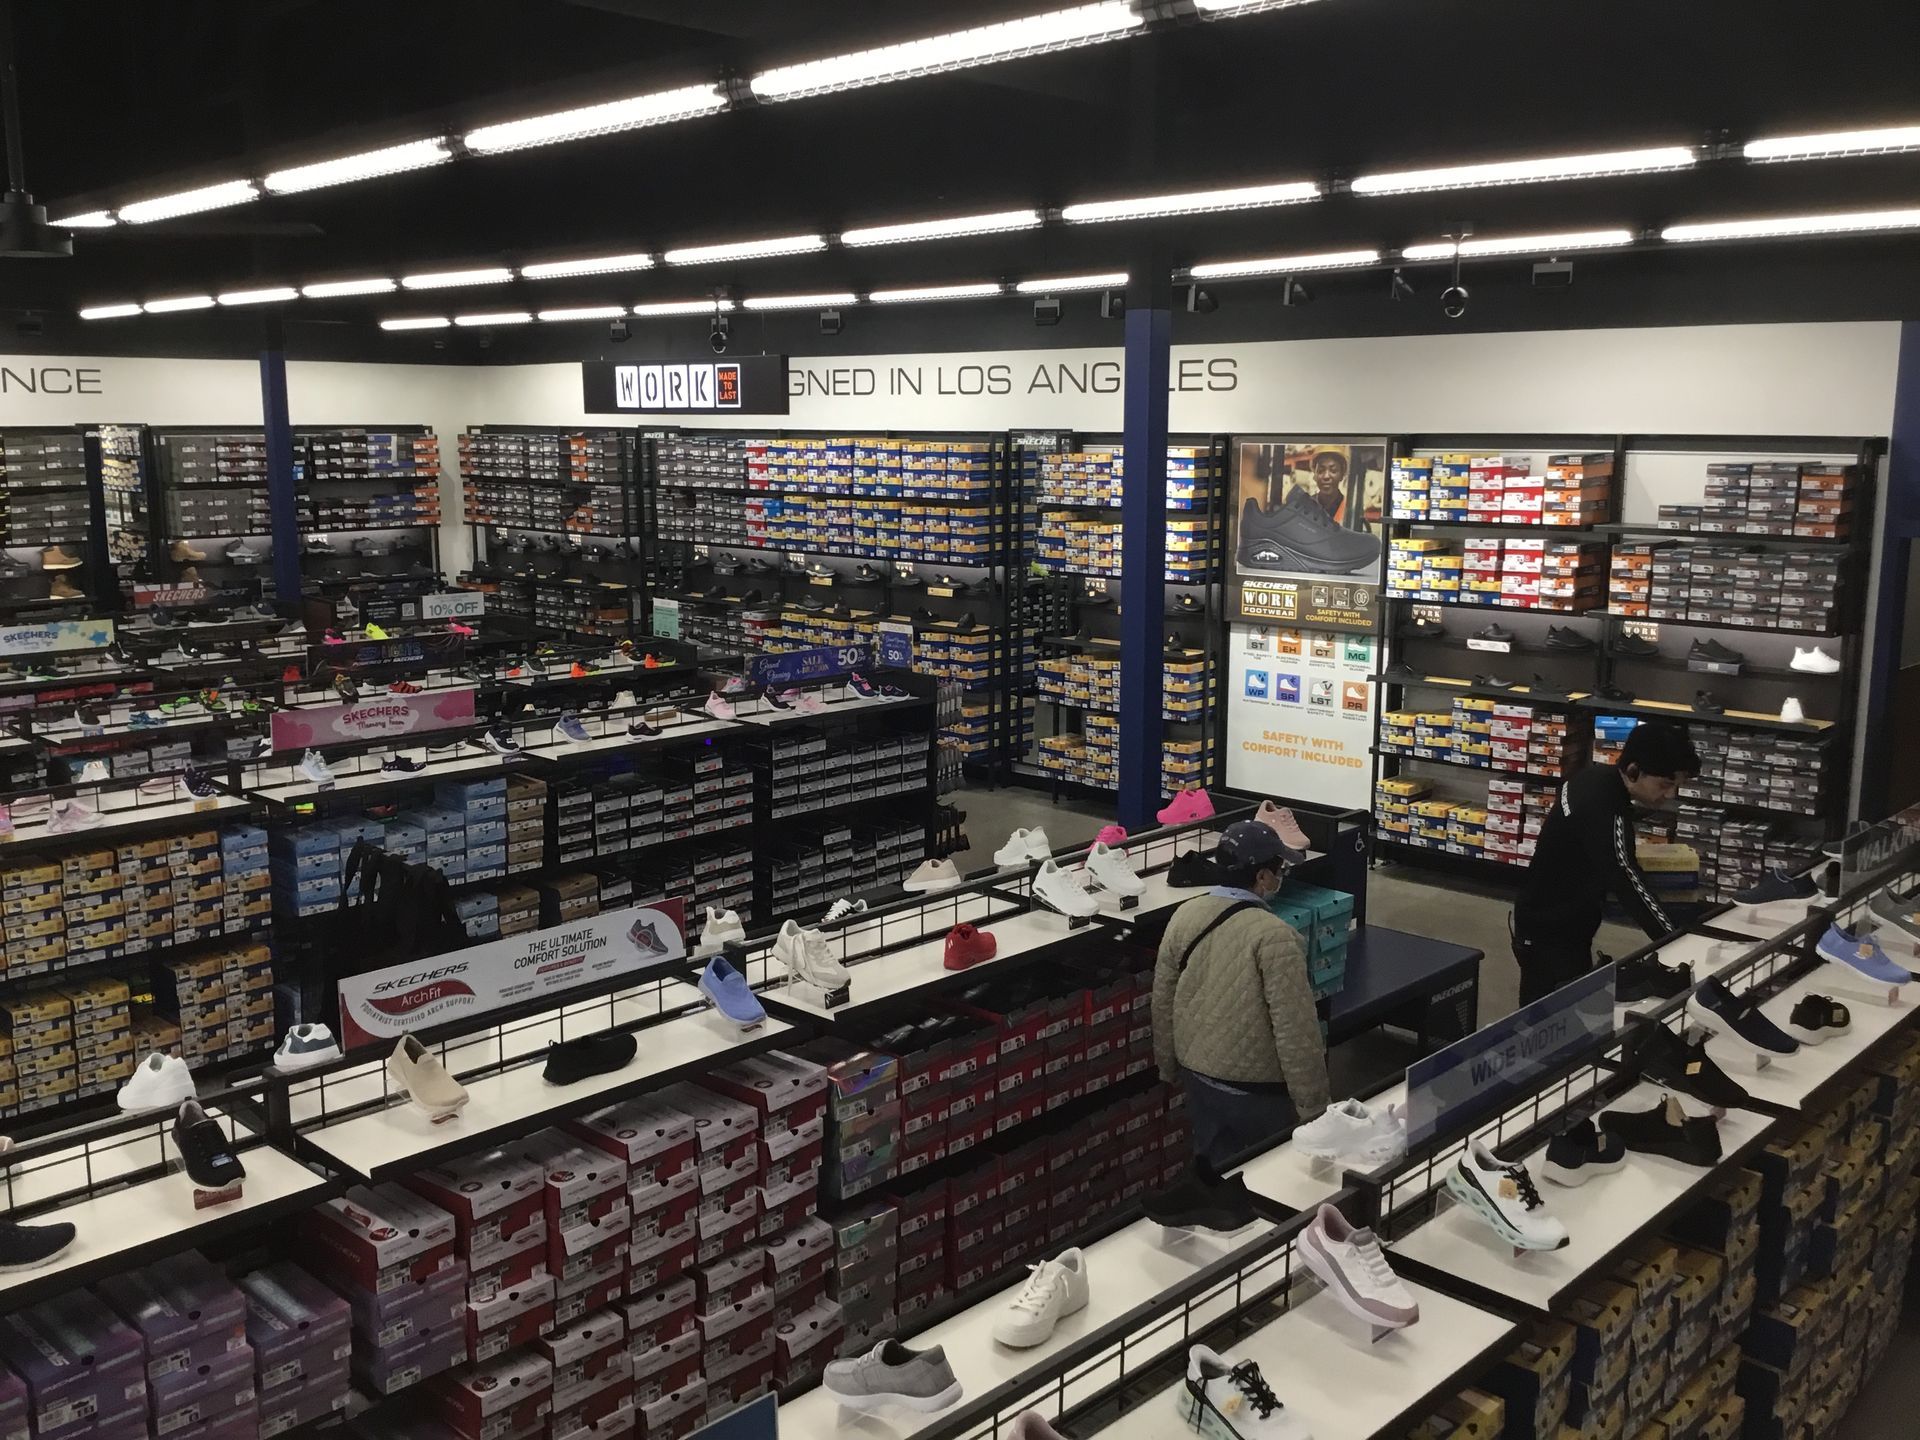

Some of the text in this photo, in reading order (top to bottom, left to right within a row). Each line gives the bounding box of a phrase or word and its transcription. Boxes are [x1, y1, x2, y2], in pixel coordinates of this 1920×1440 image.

[1, 367, 103, 394] NCE
[718, 371, 737, 381] MADE
[890, 367, 921, 395] IN
[938, 364, 1011, 395] LOS
[1027, 358, 1238, 395] ANGES
[621, 370, 707, 402] WORK
[723, 381, 733, 390] TO
[719, 391, 737, 400] LAST
[1243, 580, 1299, 591] SKECHERS
[152, 588, 207, 602] SKECHERS
[1244, 591, 1295, 608] WORK
[429, 601, 478, 616] 10% OFF
[1244, 606, 1295, 617] FOOTWEAR
[1317, 608, 1360, 619] SAFETY WITH
[1305, 614, 1372, 627] COMFORT INCLUDED
[3, 631, 58, 643] SKECHERS
[1251, 641, 1265, 649] ST
[1282, 645, 1297, 653] EH
[1315, 649, 1330, 657] CT
[1348, 652, 1366, 661] MG
[1248, 688, 1265, 697] WP
[1280, 692, 1295, 701] SR
[1311, 697, 1331, 706] LST
[1347, 701, 1363, 710] PR
[343, 705, 409, 724] SKECHERS
[1263, 730, 1344, 751] SAFETY WITH
[1242, 741, 1363, 769] COMFORT INCLUDED
[528, 928, 593, 954] THE ULTIMATE
[514, 936, 607, 970] COMFORT SOLUTION
[373, 961, 469, 994] SKECHERS
[361, 996, 476, 1027] PODIATRIST CERTIFIED ARCH SUPPORT
[1471, 1017, 1567, 1087] WIDE WIDTH
